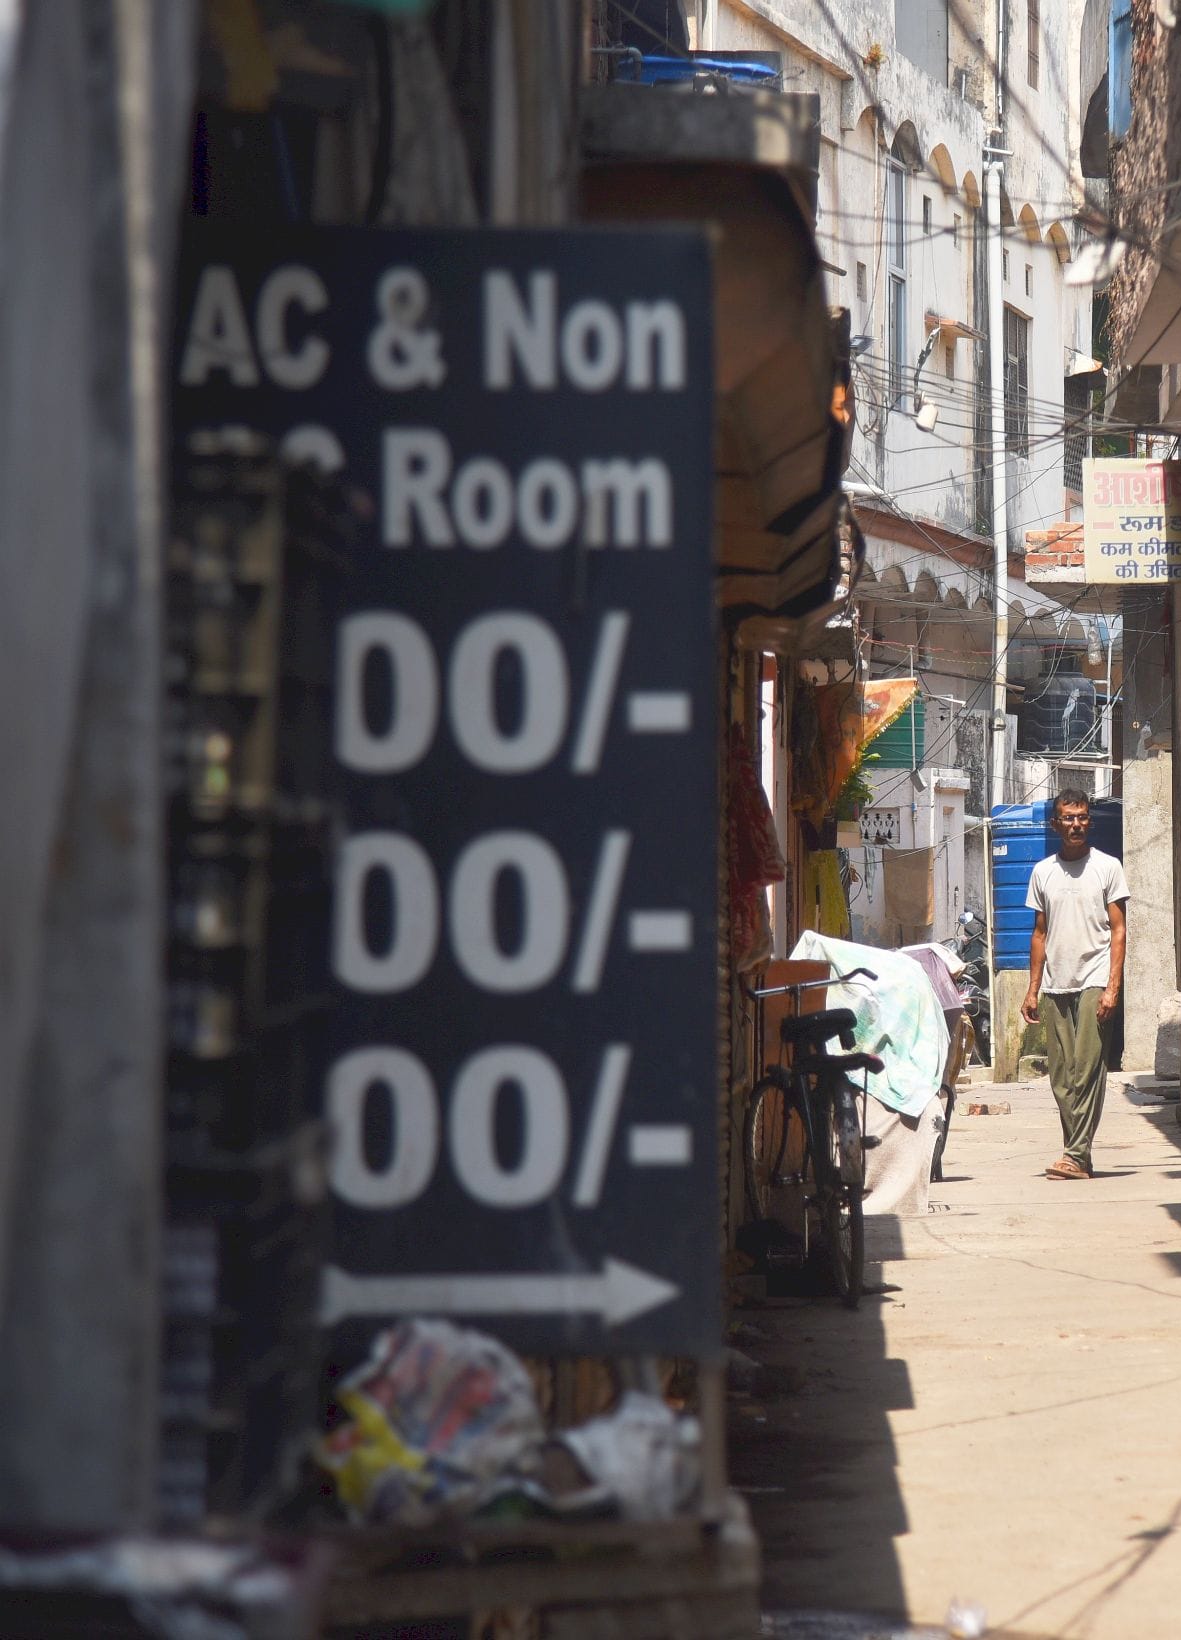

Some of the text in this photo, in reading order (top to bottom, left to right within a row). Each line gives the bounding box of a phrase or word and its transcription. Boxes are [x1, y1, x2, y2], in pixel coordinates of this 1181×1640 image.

[180, 265, 687, 392] AC & Non
[383, 427, 674, 549] Room
[1119, 516, 1163, 532] रूम
[1100, 542, 1133, 556] कम
[1115, 560, 1139, 579] की
